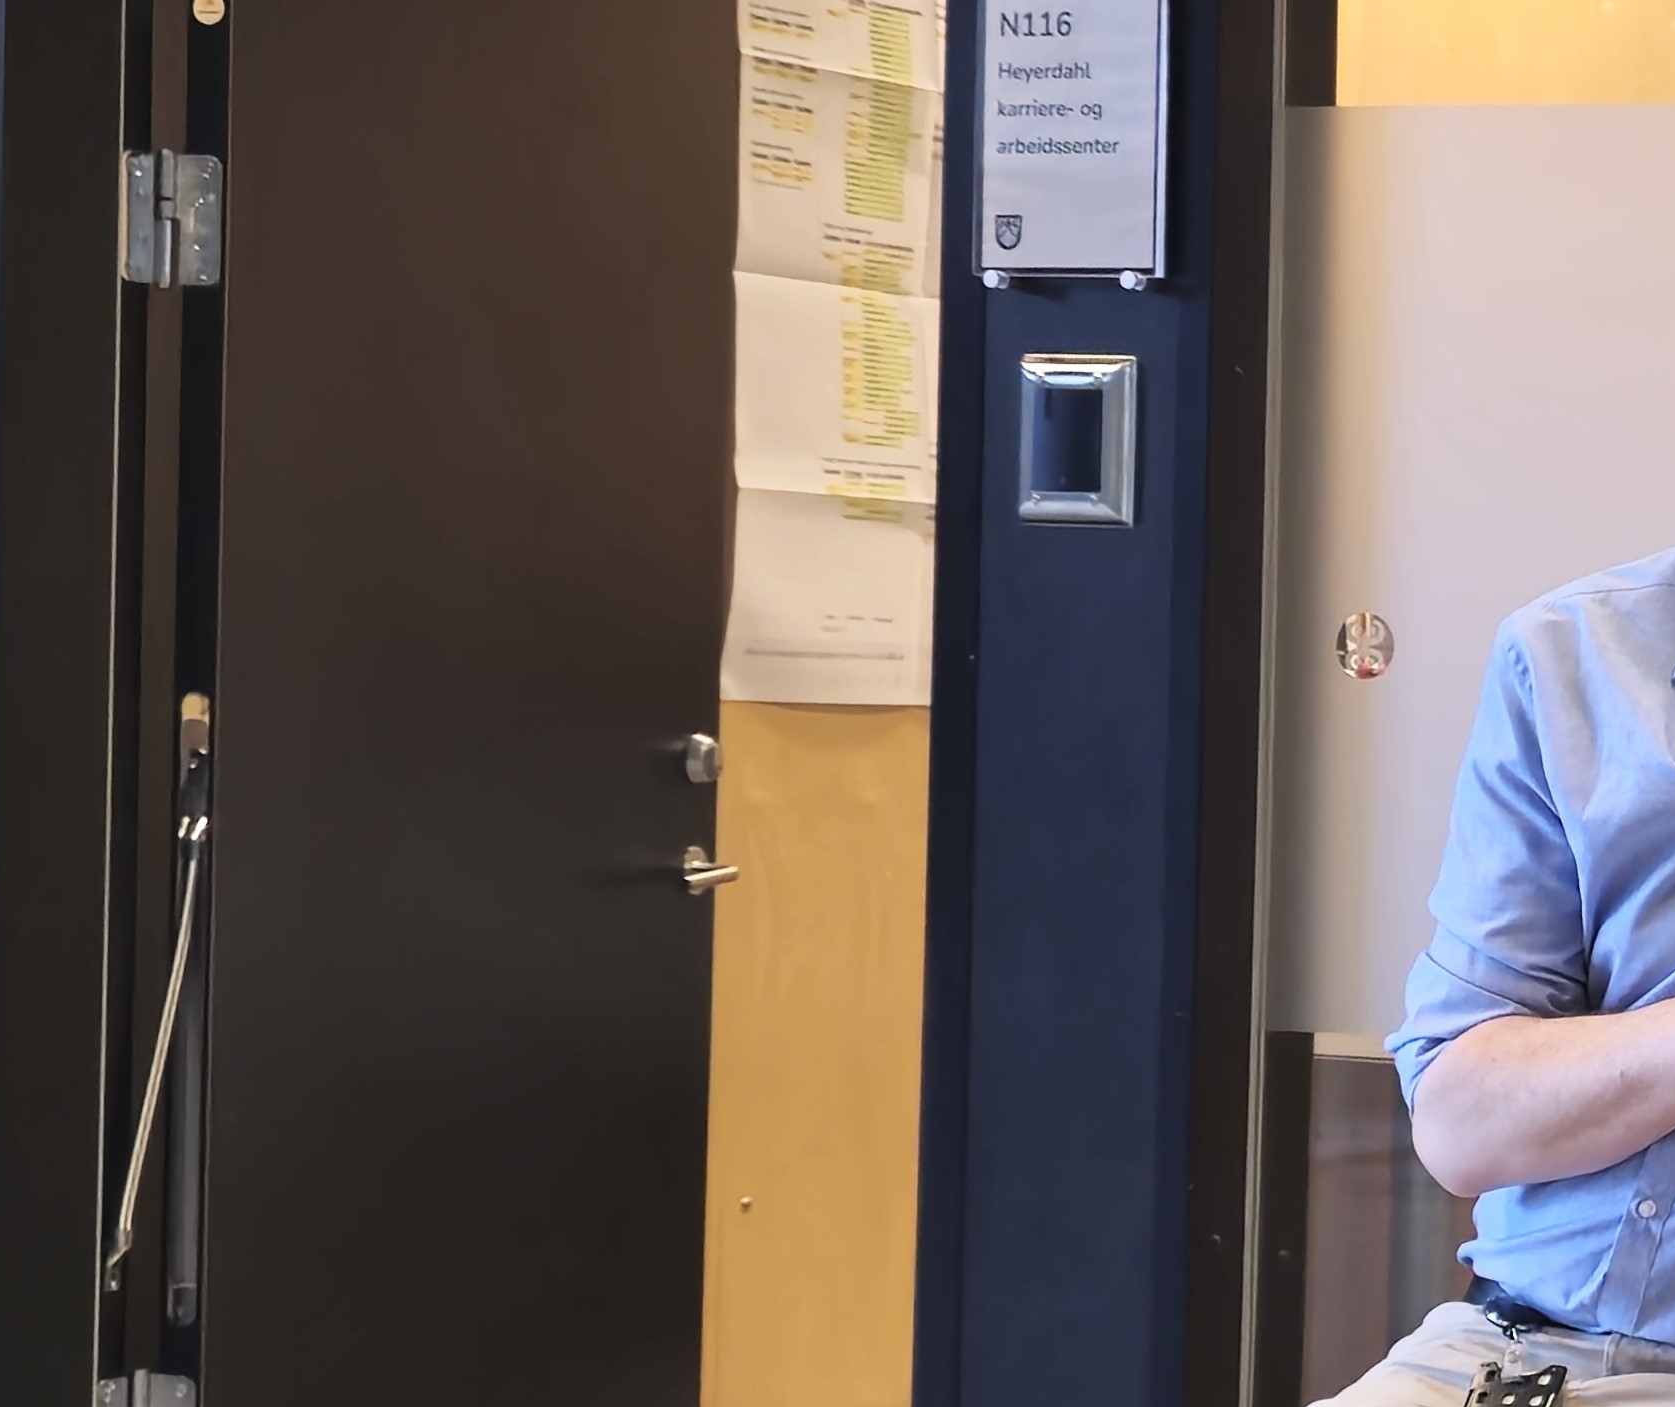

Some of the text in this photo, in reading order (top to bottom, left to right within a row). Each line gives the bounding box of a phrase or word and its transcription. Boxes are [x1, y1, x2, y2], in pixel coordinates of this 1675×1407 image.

[1000, 11, 1072, 37] N116
[998, 61, 1092, 84] Heyerdahl
[997, 99, 1103, 121] karriere- og
[996, 136, 1120, 155] arbeidssenter
